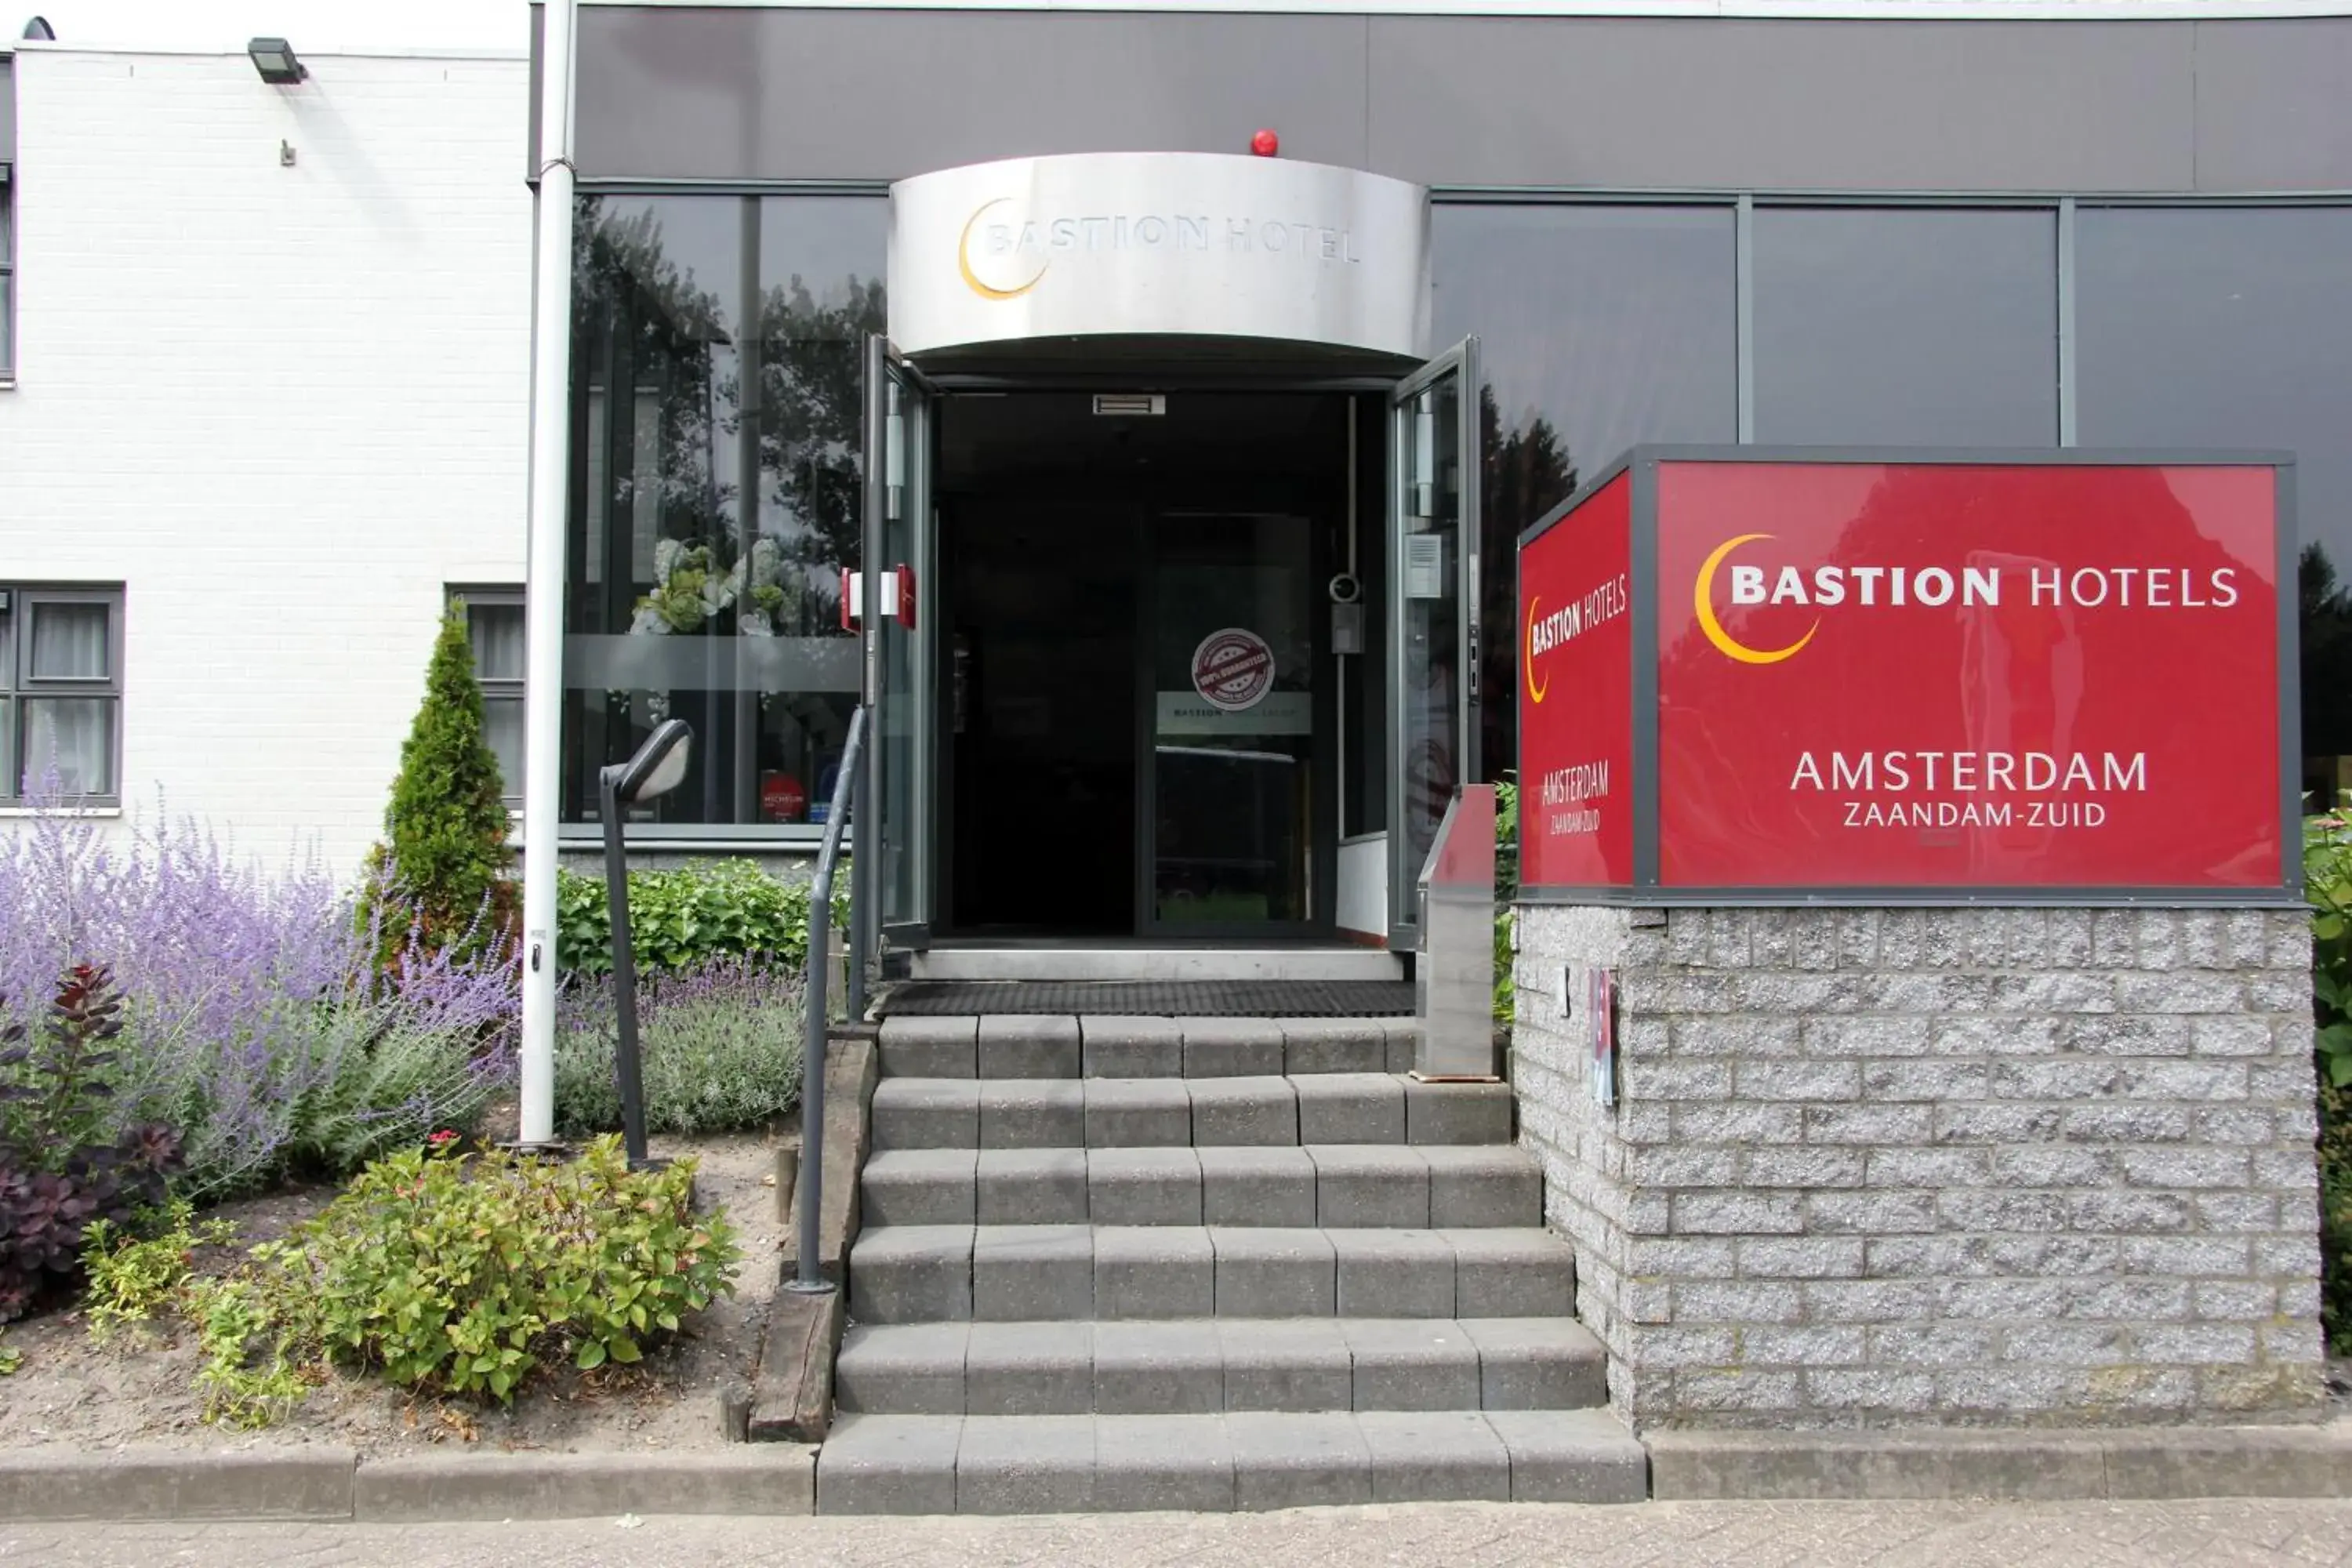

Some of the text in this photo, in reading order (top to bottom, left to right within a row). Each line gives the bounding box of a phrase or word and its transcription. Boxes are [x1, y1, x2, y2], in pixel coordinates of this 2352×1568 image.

[986, 213, 1362, 265] BASTION HOTEL
[1730, 565, 2238, 608] BASTION HOTELS
[1533, 573, 1627, 657] BASTION HOTELS
[1542, 757, 1609, 807] AMSTERDAM
[1789, 750, 2147, 792] AMSTERDAM
[1842, 801, 2106, 828] ZAANDAM-ZUID
